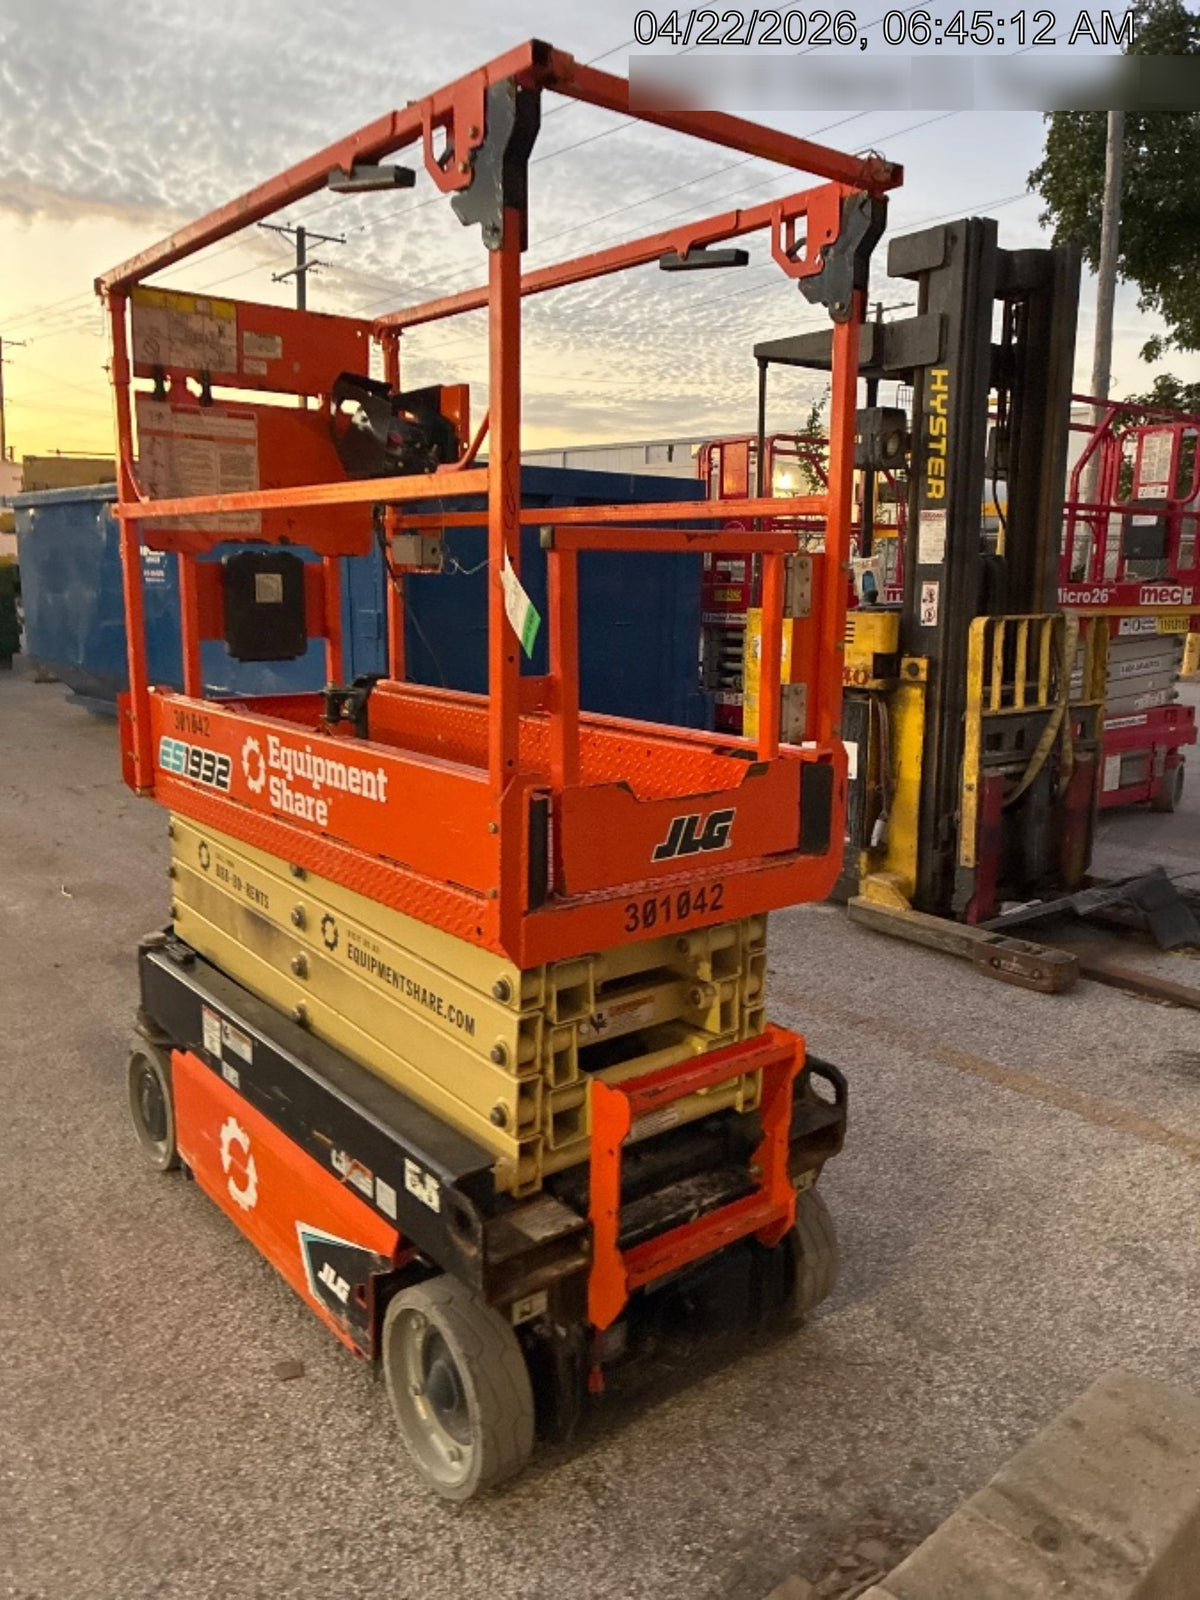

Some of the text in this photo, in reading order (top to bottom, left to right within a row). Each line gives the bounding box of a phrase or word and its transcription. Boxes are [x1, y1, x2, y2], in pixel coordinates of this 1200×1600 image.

[926, 368, 949, 499] HYSTER
[1057, 588, 1109, 604] icro26
[1140, 586, 1182, 606] mec
[159, 736, 231, 793] ES1932
[266, 734, 388, 803] Equipment
[269, 775, 329, 827] Share
[651, 807, 736, 862] JLG
[624, 883, 725, 932] 301042
[347, 943, 475, 1036] EQUIPMENTSHARE.COM
[317, 1262, 351, 1305] JLG
